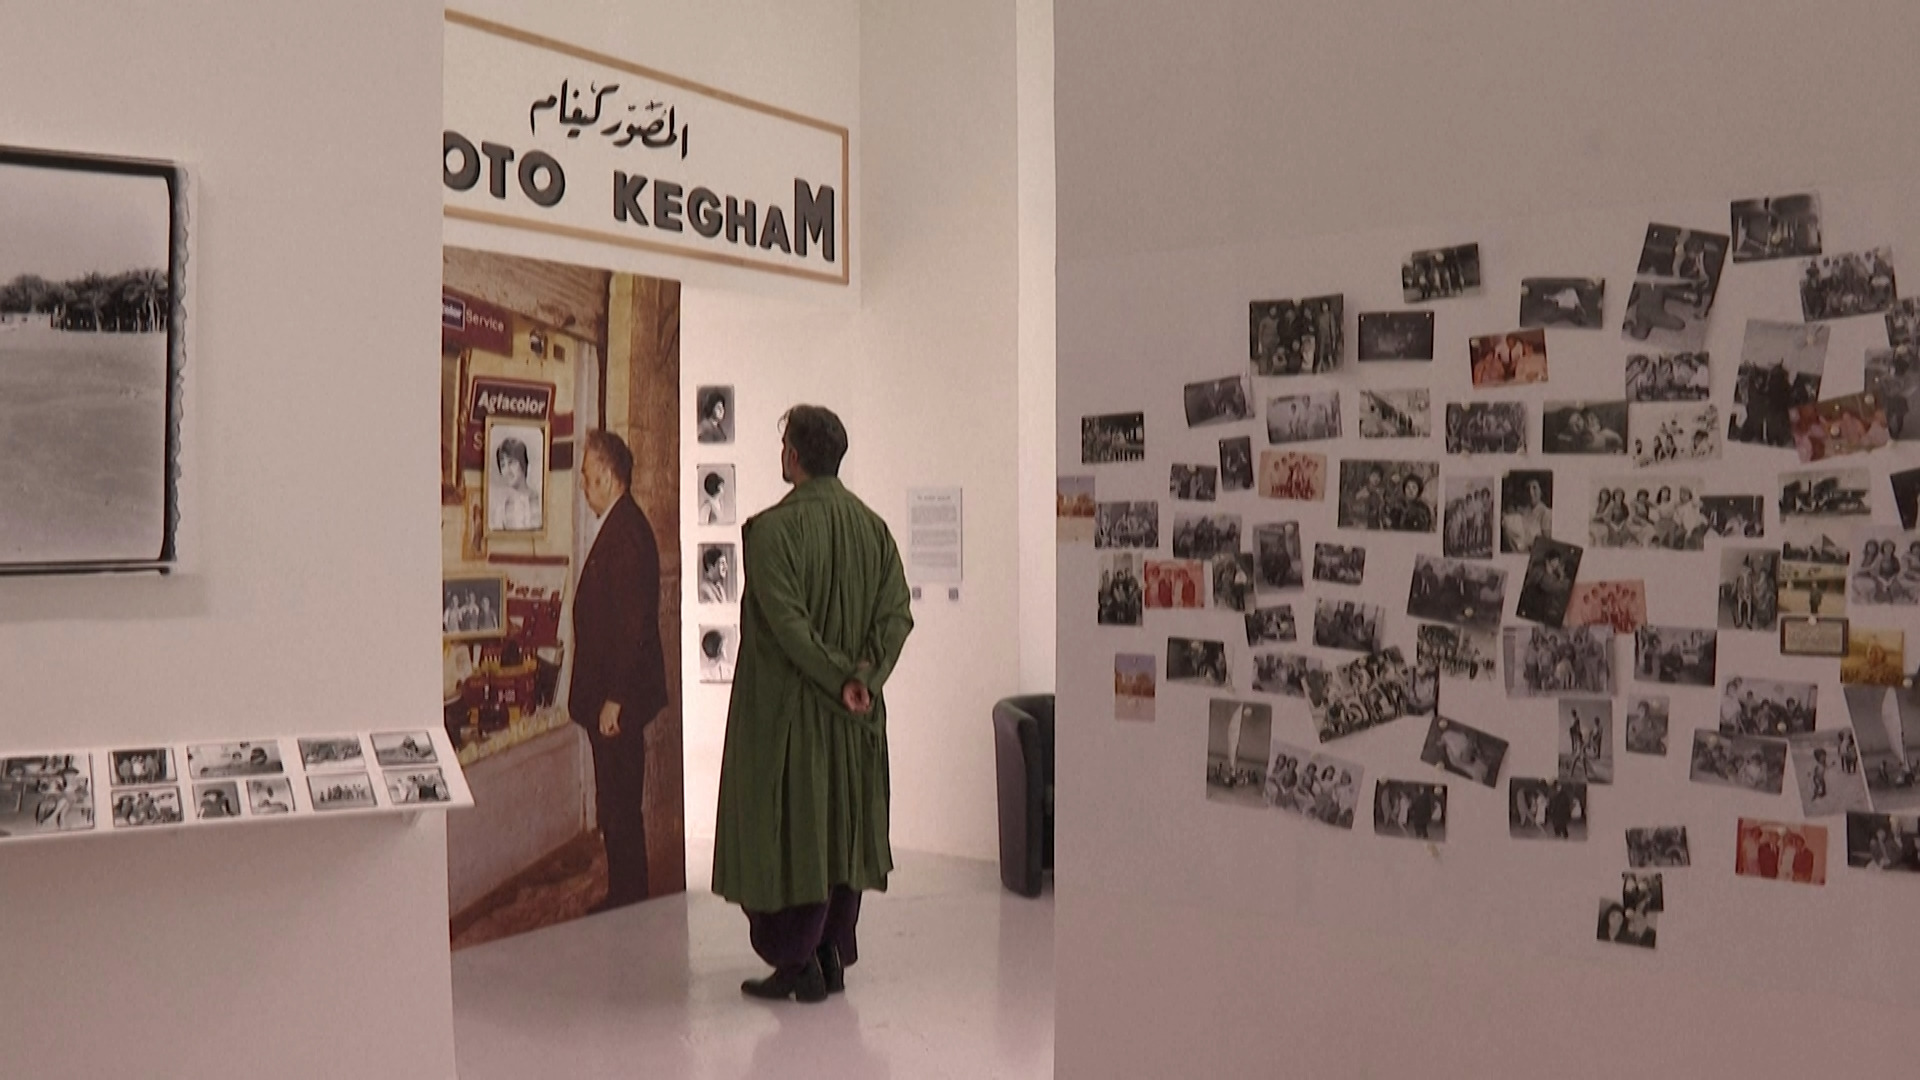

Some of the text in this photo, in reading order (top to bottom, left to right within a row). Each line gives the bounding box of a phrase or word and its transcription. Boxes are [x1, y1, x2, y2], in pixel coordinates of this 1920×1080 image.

[613, 169, 835, 263] KEGHAM
[466, 309, 504, 332] Service
[478, 390, 546, 414] Agfacolor
